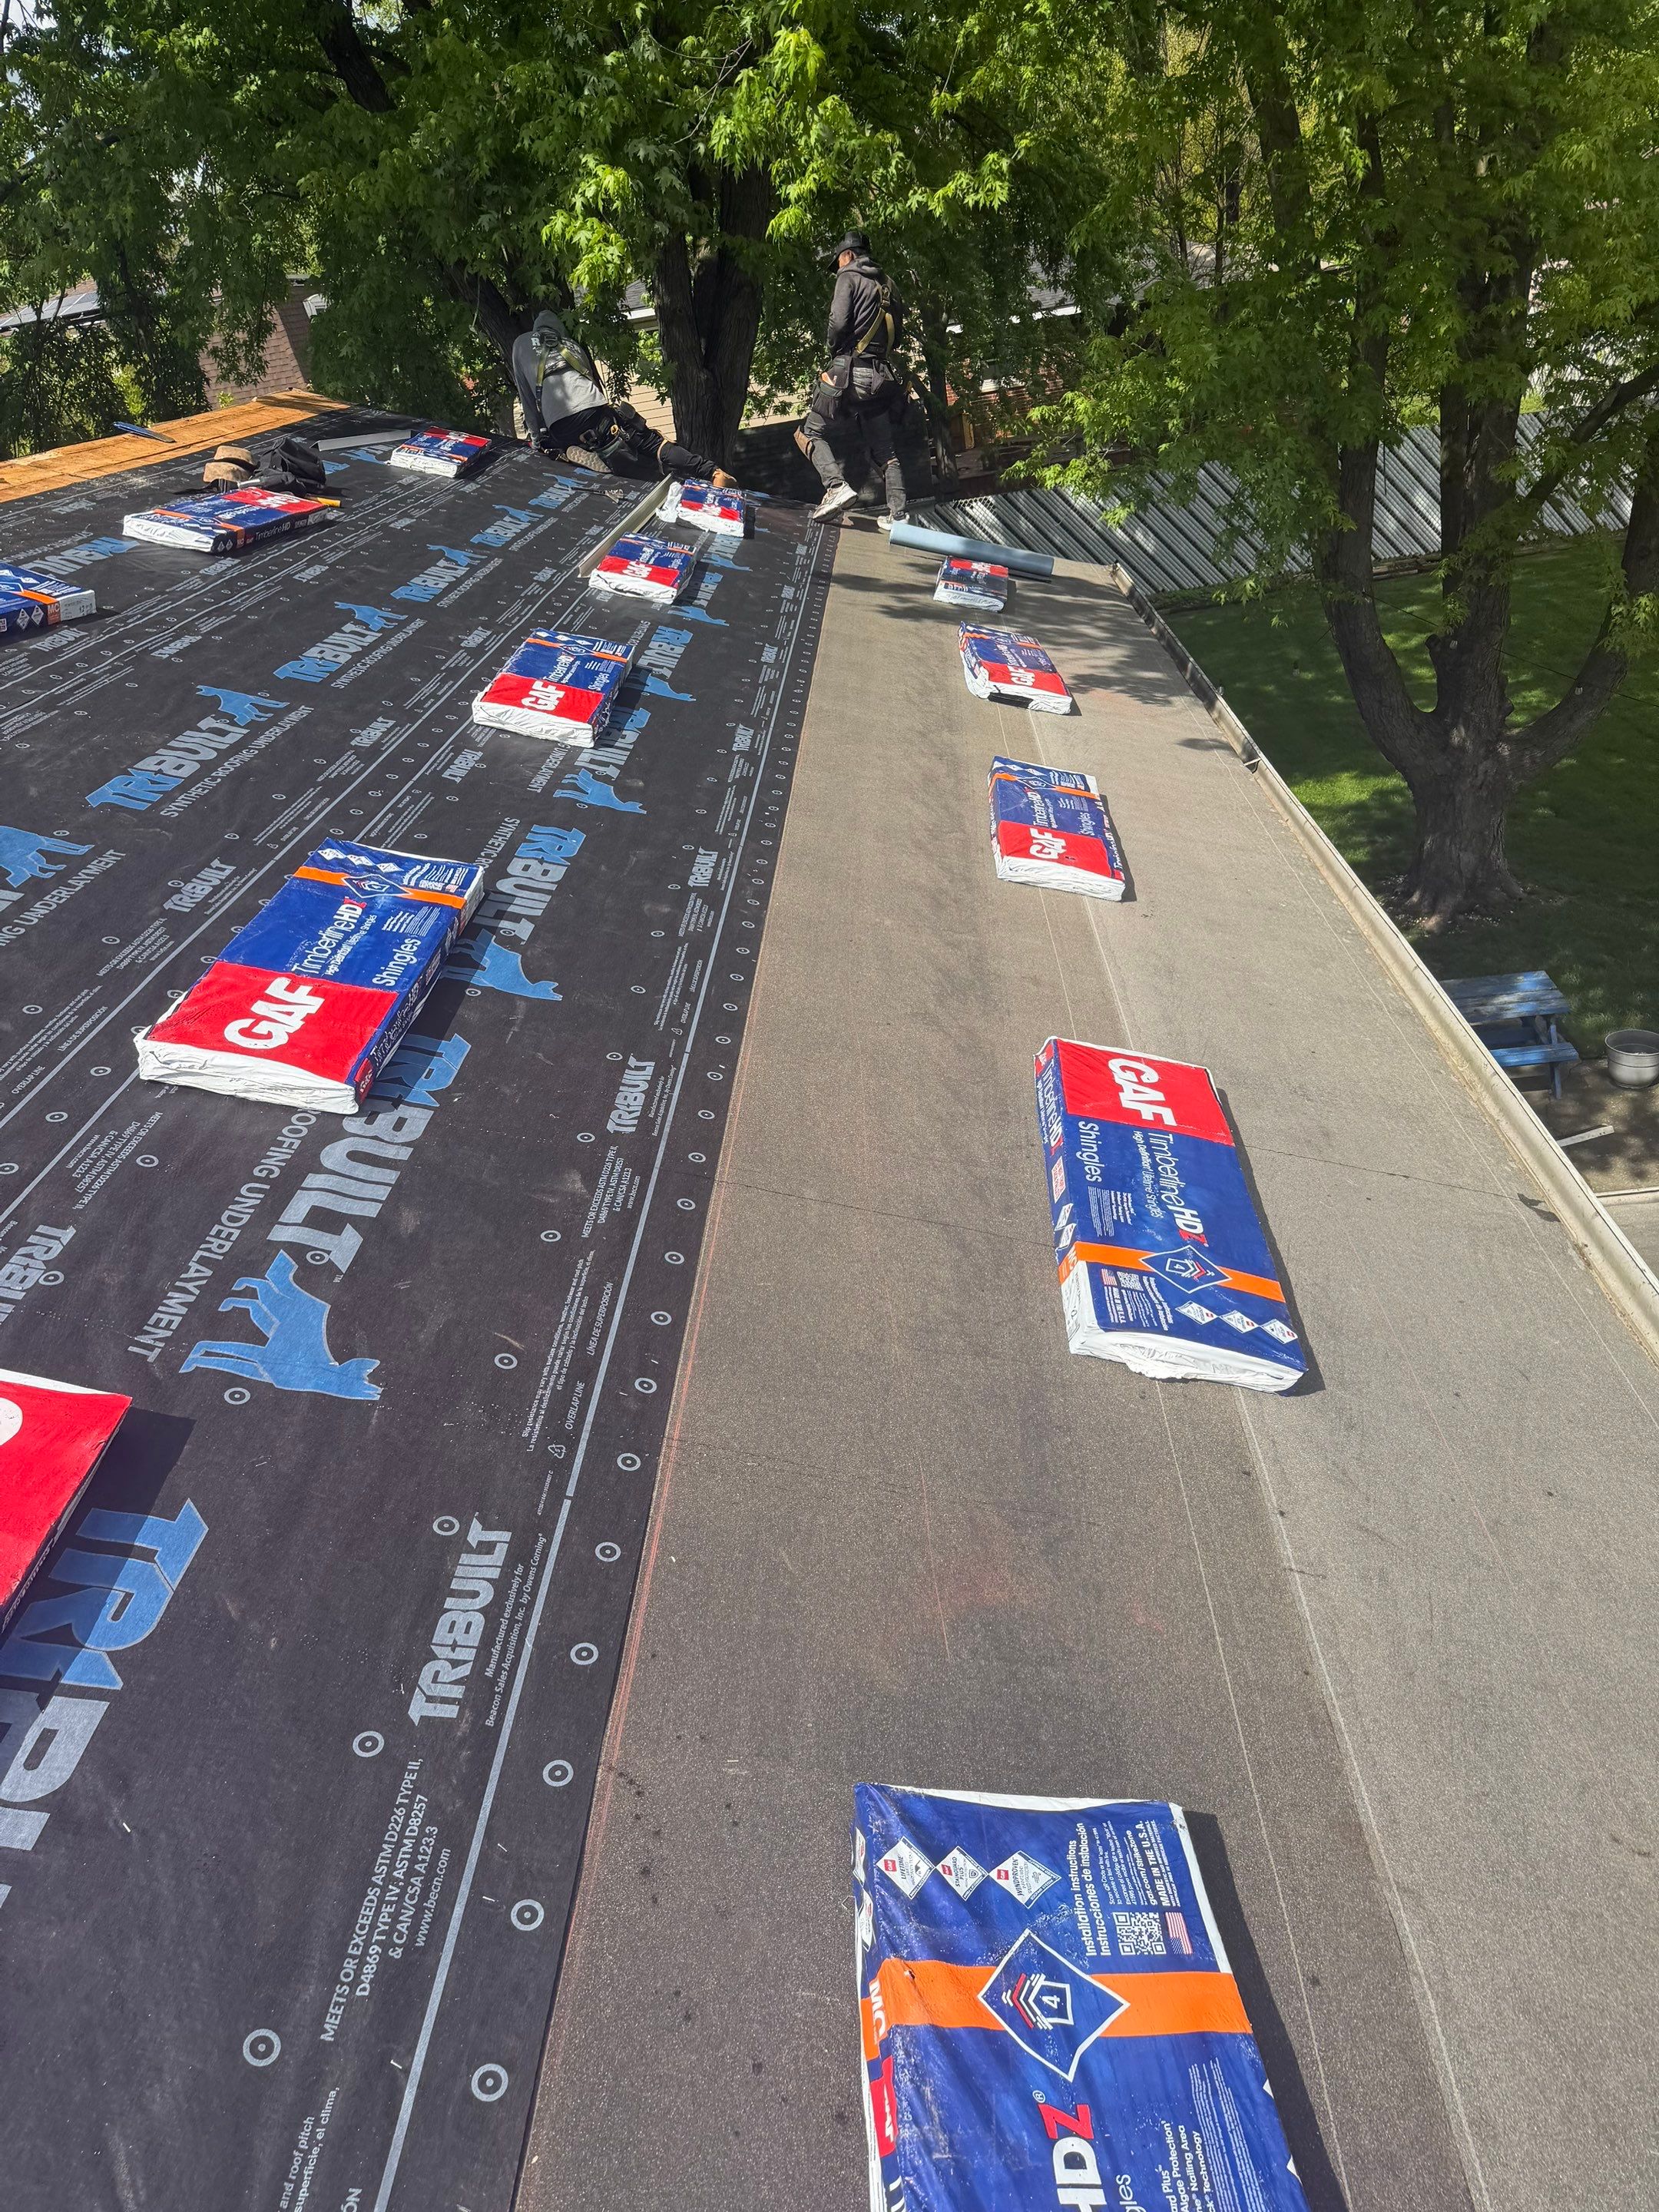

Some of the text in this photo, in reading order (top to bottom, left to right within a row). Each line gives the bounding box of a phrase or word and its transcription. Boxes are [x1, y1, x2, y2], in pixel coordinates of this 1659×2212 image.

[469, 516, 531, 547] TRIBUILT
[390, 559, 469, 603] TRIBUILT
[48, 604, 61, 614] MC
[29, 628, 88, 652] TRIBUILT
[273, 622, 382, 682] TRIBUILT
[331, 618, 428, 689] SYNTHETIC ROOFING UNDERLAYMENT
[636, 626, 694, 679] TRIBUILT
[522, 680, 565, 710] GAF
[1007, 665, 1035, 687] GAF
[350, 716, 397, 747] TRIBUILT
[85, 714, 250, 812] TRIBUILT
[161, 706, 314, 817] SYNTHETIC ROOFING UNDERLAYMENT
[442, 748, 484, 784] TRIBUILT
[485, 816, 521, 860] SYNTHETIC
[1030, 827, 1067, 859] GAF
[1079, 812, 1096, 836] Shingles
[22, 849, 127, 927] UNDERLAYMENT
[163, 857, 237, 913] TRIBUILT
[469, 824, 586, 945] TRIBUILT
[688, 846, 718, 887] TRIBUILT
[373, 936, 422, 987] Shingles
[224, 977, 326, 1049] GAF
[607, 1055, 655, 1134] TRIBUILT
[1108, 1058, 1177, 1128] GAF
[89, 1133, 114, 1157] CAN/CSA
[109, 1138, 127, 1151] TYPE
[144, 1112, 163, 1128] MEETS
[89, 1158, 108, 1174] ASTM
[104, 1159, 122, 1177] ASTM
[118, 1136, 142, 1159] EXCEEDS
[1076, 1121, 1104, 1181] Shingles
[79, 1190, 97, 1206] TYPE
[92, 1175, 109, 1190] D226
[1133, 1131, 1144, 1144] High
[1145, 1194, 1164, 1218] Shingles
[581, 1220, 594, 1237] MEETS
[590, 1189, 604, 1210] EXCEEDS
[598, 1172, 608, 1188] ASTM
[127, 1108, 320, 1363] OOFING UNDERLAYMENT
[565, 1381, 584, 1429] OVERLAP LINE
[408, 1518, 512, 1726] TRIBUILT
[485, 1564, 524, 1677] Manufactured exclusively for
[485, 1567, 536, 1727] Beacon Sales Acquisition, Inc. by Owens
[1136, 1821, 1151, 1847] U.S.A.
[1145, 1849, 1157, 1865] THE
[389, 1826, 438, 1959] & CAN/CSA A123.3
[898, 1856, 906, 1879] LIFETIME
[1076, 1823, 1111, 1955] Instrucciones de instalación
[1151, 1868, 1161, 1876] IN
[1154, 1877, 1171, 1906] MADE
[320, 1759, 422, 2041] MEETS OR EXCEEDS ASTM D226 TYPE II,
[356, 1795, 427, 1995] D4869 TYPE ASTM D8257
[416, 1849, 451, 1945] www.becn.com
[1067, 1840, 1097, 1955] Installation instructions
[316, 2088, 339, 2140] el clima,
[280, 2117, 314, 2208] and roof pitch
[1178, 2124, 1198, 2191] Nailing Area
[1192, 2131, 1210, 2194] Technology
